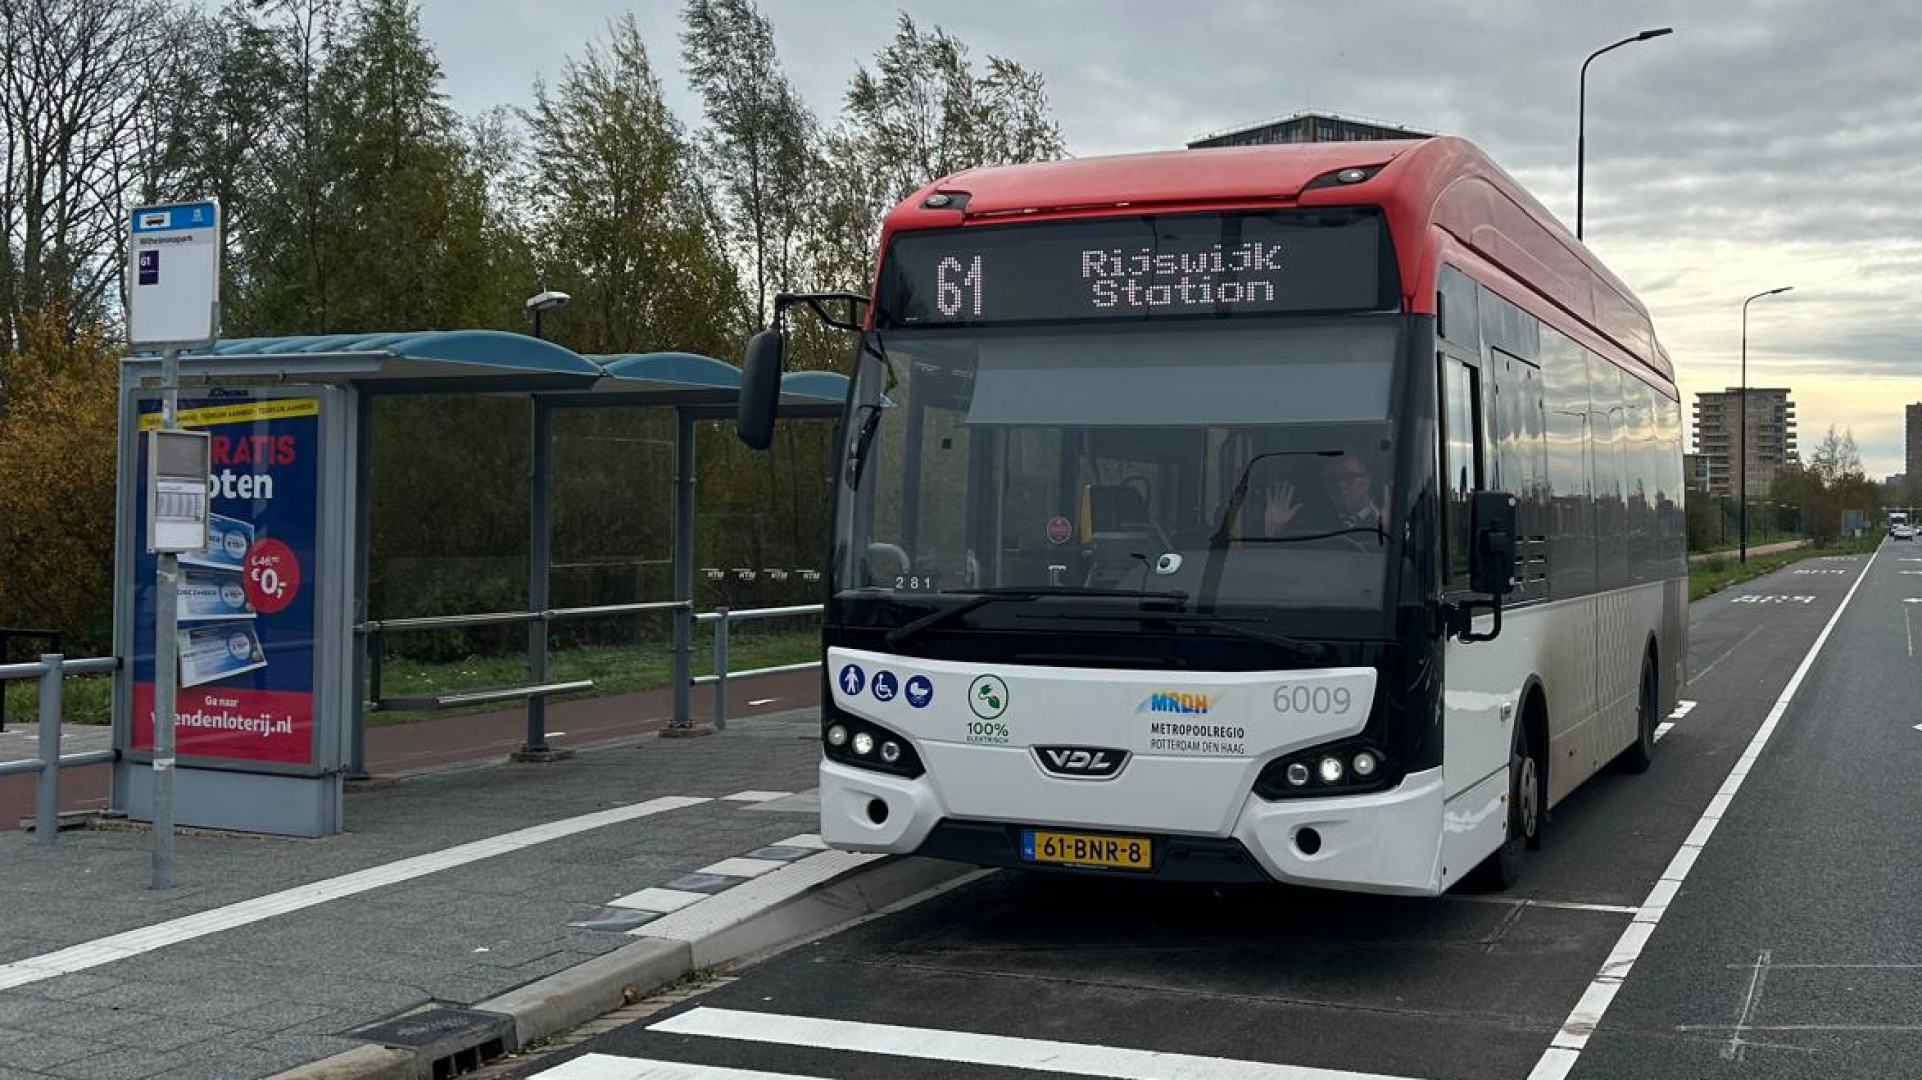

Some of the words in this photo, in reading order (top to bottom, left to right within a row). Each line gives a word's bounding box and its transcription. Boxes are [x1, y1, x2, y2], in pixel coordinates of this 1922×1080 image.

[140, 255, 151, 267] 61
[1082, 242, 1281, 278] Rijswijk
[936, 255, 982, 316] 61
[1092, 275, 1274, 308] Station
[212, 435, 296, 465] RATIS
[209, 468, 273, 499] oten
[895, 576, 931, 589] 281
[205, 695, 218, 706] Ga
[219, 697, 240, 708] naar
[1150, 691, 1210, 714] MRDH
[1273, 685, 1351, 715] 6009
[151, 710, 293, 737] endenloterij.nl
[967, 722, 1009, 737] 100%
[1151, 722, 1245, 739] METROPOOLREGIO
[1151, 738, 1200, 752] ROTTERDAM
[1202, 742, 1220, 753] DEN
[1221, 743, 1245, 755] HAAG
[1045, 750, 1112, 769] VDL
[1043, 837, 1142, 863] 61-BNR-8
